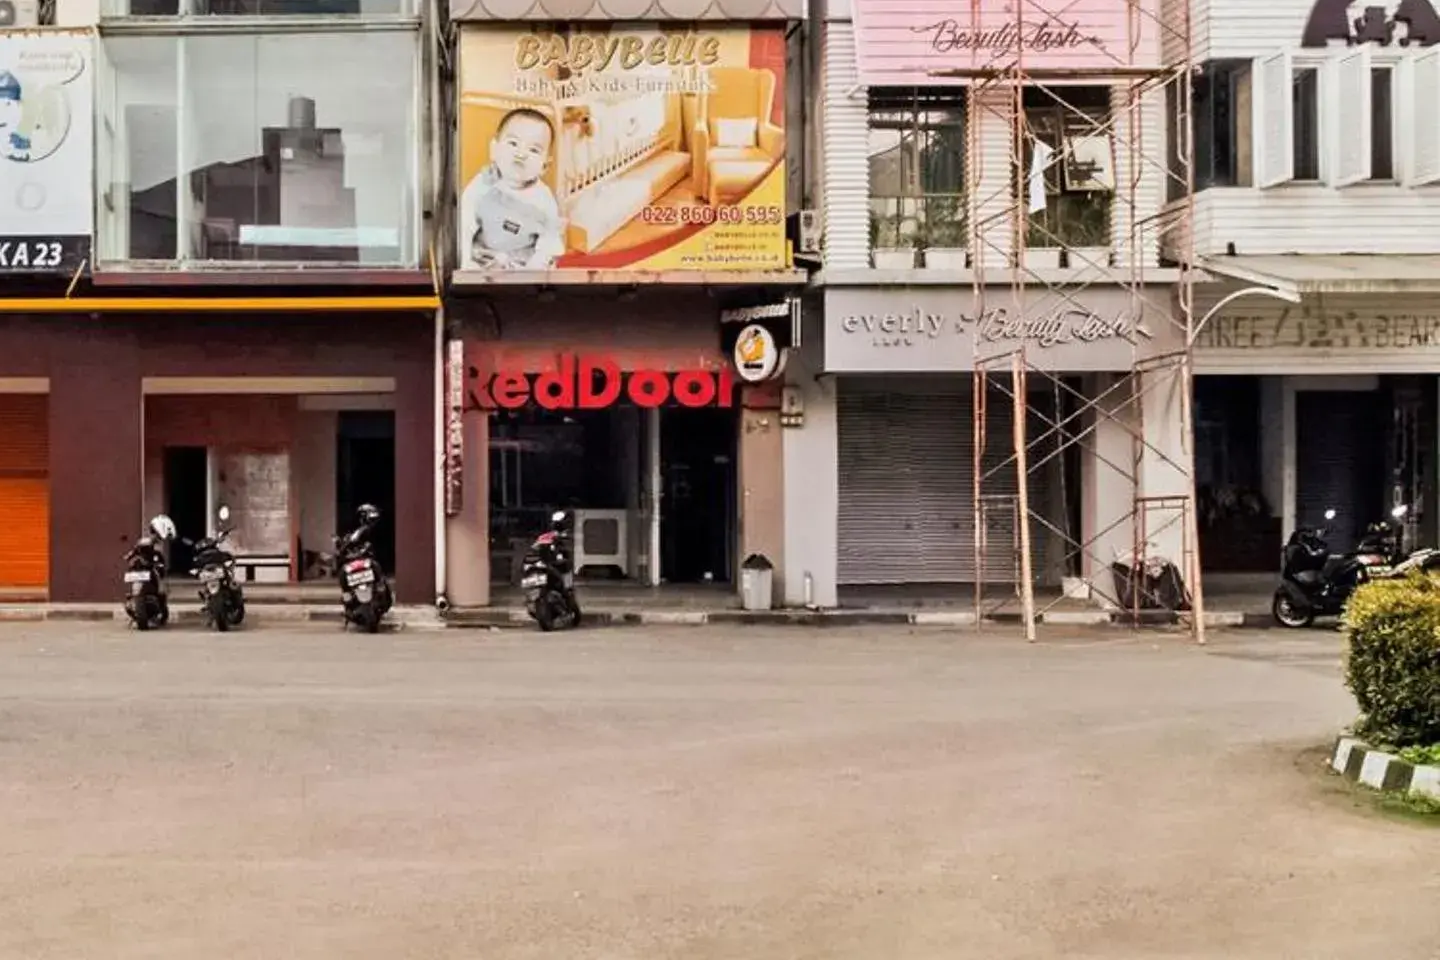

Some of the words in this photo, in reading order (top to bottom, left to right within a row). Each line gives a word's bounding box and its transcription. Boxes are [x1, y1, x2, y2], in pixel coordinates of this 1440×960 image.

[642, 206, 675, 223] 022
[680, 206, 712, 224] 860
[718, 206, 744, 223] 60
[746, 206, 780, 224] 595
[12, 243, 33, 267] A
[36, 243, 63, 267] 23
[842, 305, 944, 339] everly
